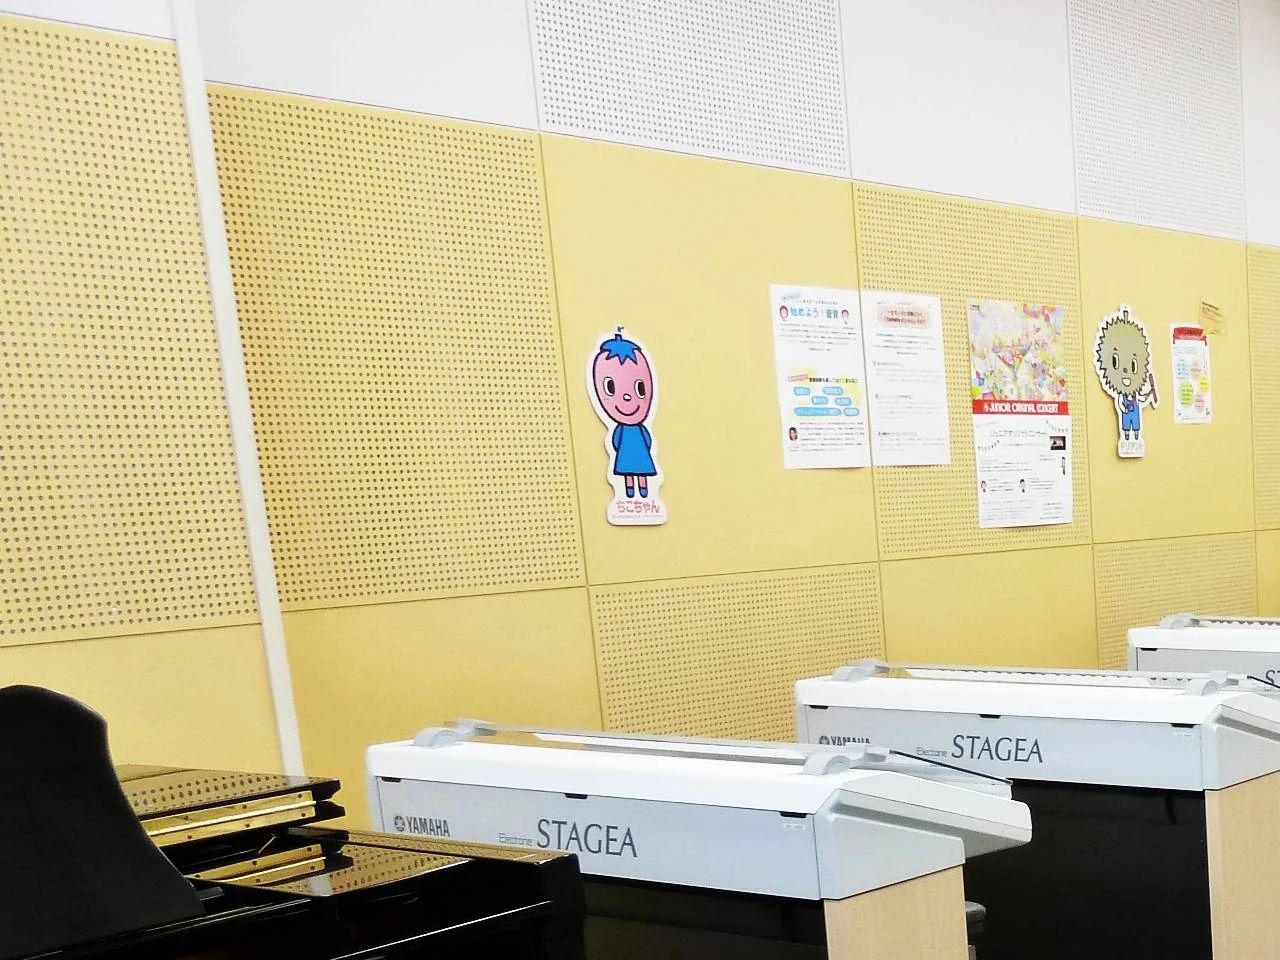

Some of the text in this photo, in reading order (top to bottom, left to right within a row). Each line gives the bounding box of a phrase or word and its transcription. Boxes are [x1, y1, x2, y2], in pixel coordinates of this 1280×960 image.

[989, 402, 1011, 412] JUNIOR
[951, 734, 1043, 763] STAGEA
[406, 815, 450, 837] YAMAHA
[537, 819, 638, 858] STAGEA
